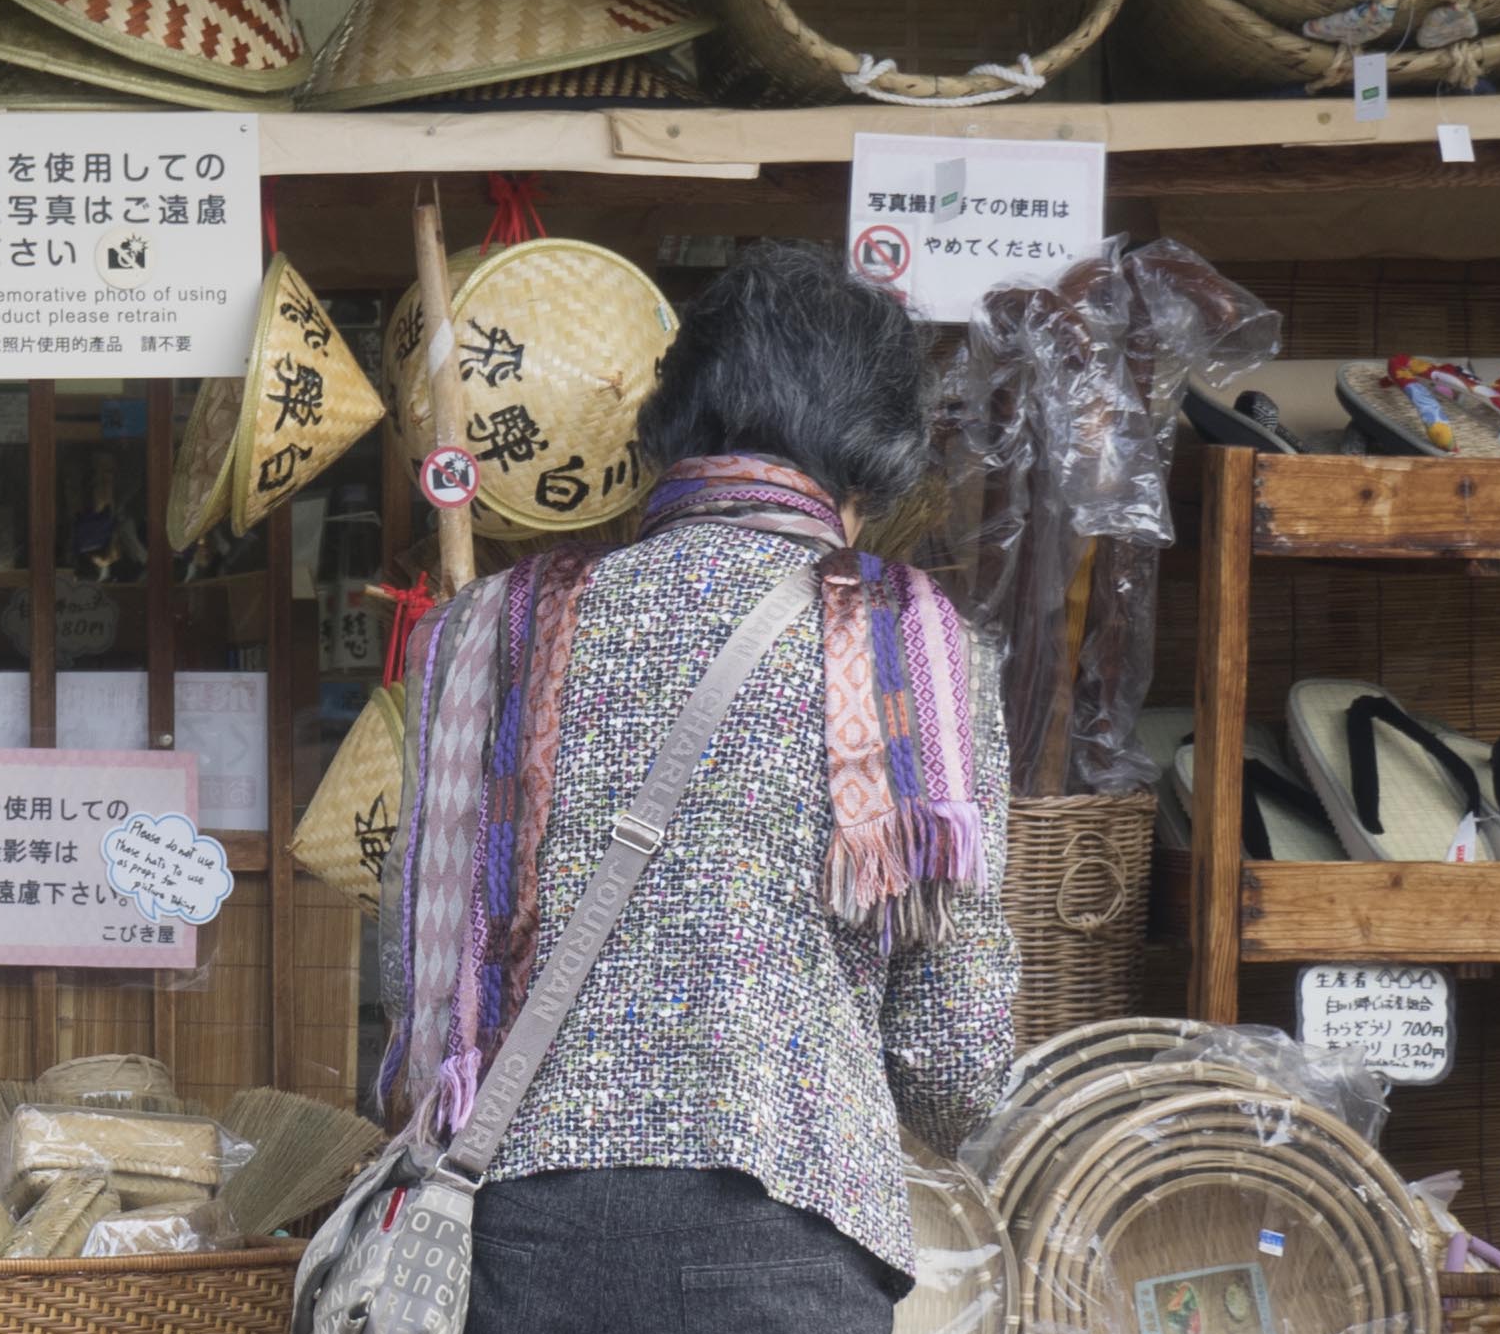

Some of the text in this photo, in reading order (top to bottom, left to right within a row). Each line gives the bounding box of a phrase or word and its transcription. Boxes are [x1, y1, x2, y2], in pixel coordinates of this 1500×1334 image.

[868, 191, 1070, 219] 写真撮での使用は
[924, 236, 1075, 262] やめてください。
[94, 287, 146, 306] photo
[153, 287, 171, 303] of
[177, 287, 228, 305] using
[48, 308, 110, 327] please
[128, 820, 161, 844] Please
[197, 856, 215, 870] use
[116, 859, 129, 868] as
[186, 874, 205, 886] use
[101, 924, 176, 945] こびき屋
[531, 854, 629, 1023] JOURDAN
[1315, 970, 1367, 989] 生産者
[1401, 1020, 1444, 1038] 700円
[1392, 1040, 1446, 1059] 1320円
